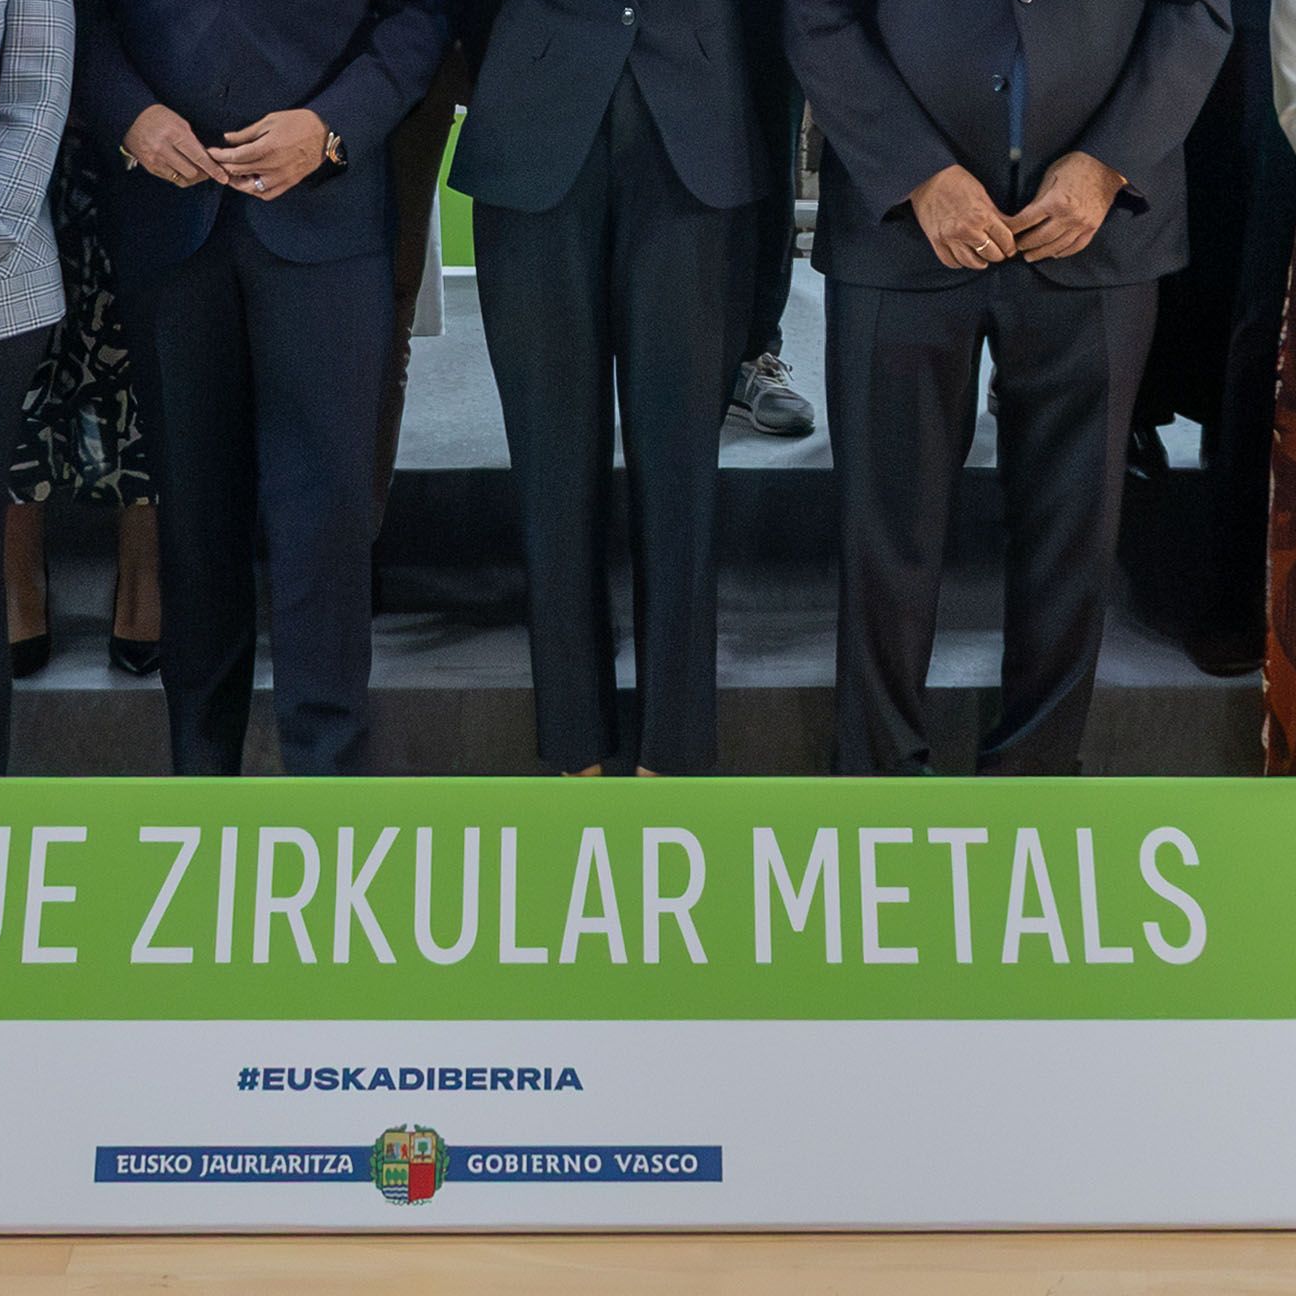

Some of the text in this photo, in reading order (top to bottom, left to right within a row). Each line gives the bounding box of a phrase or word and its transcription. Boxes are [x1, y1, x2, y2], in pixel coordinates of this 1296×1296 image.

[130, 826, 709, 965] ZIRKULAR
[751, 825, 1208, 965] METALS
[236, 1066, 584, 1091] #EUSKADIBERRIA
[116, 1153, 699, 1178] EUSKO JAURLARITZA GOBIERNO VASCO
